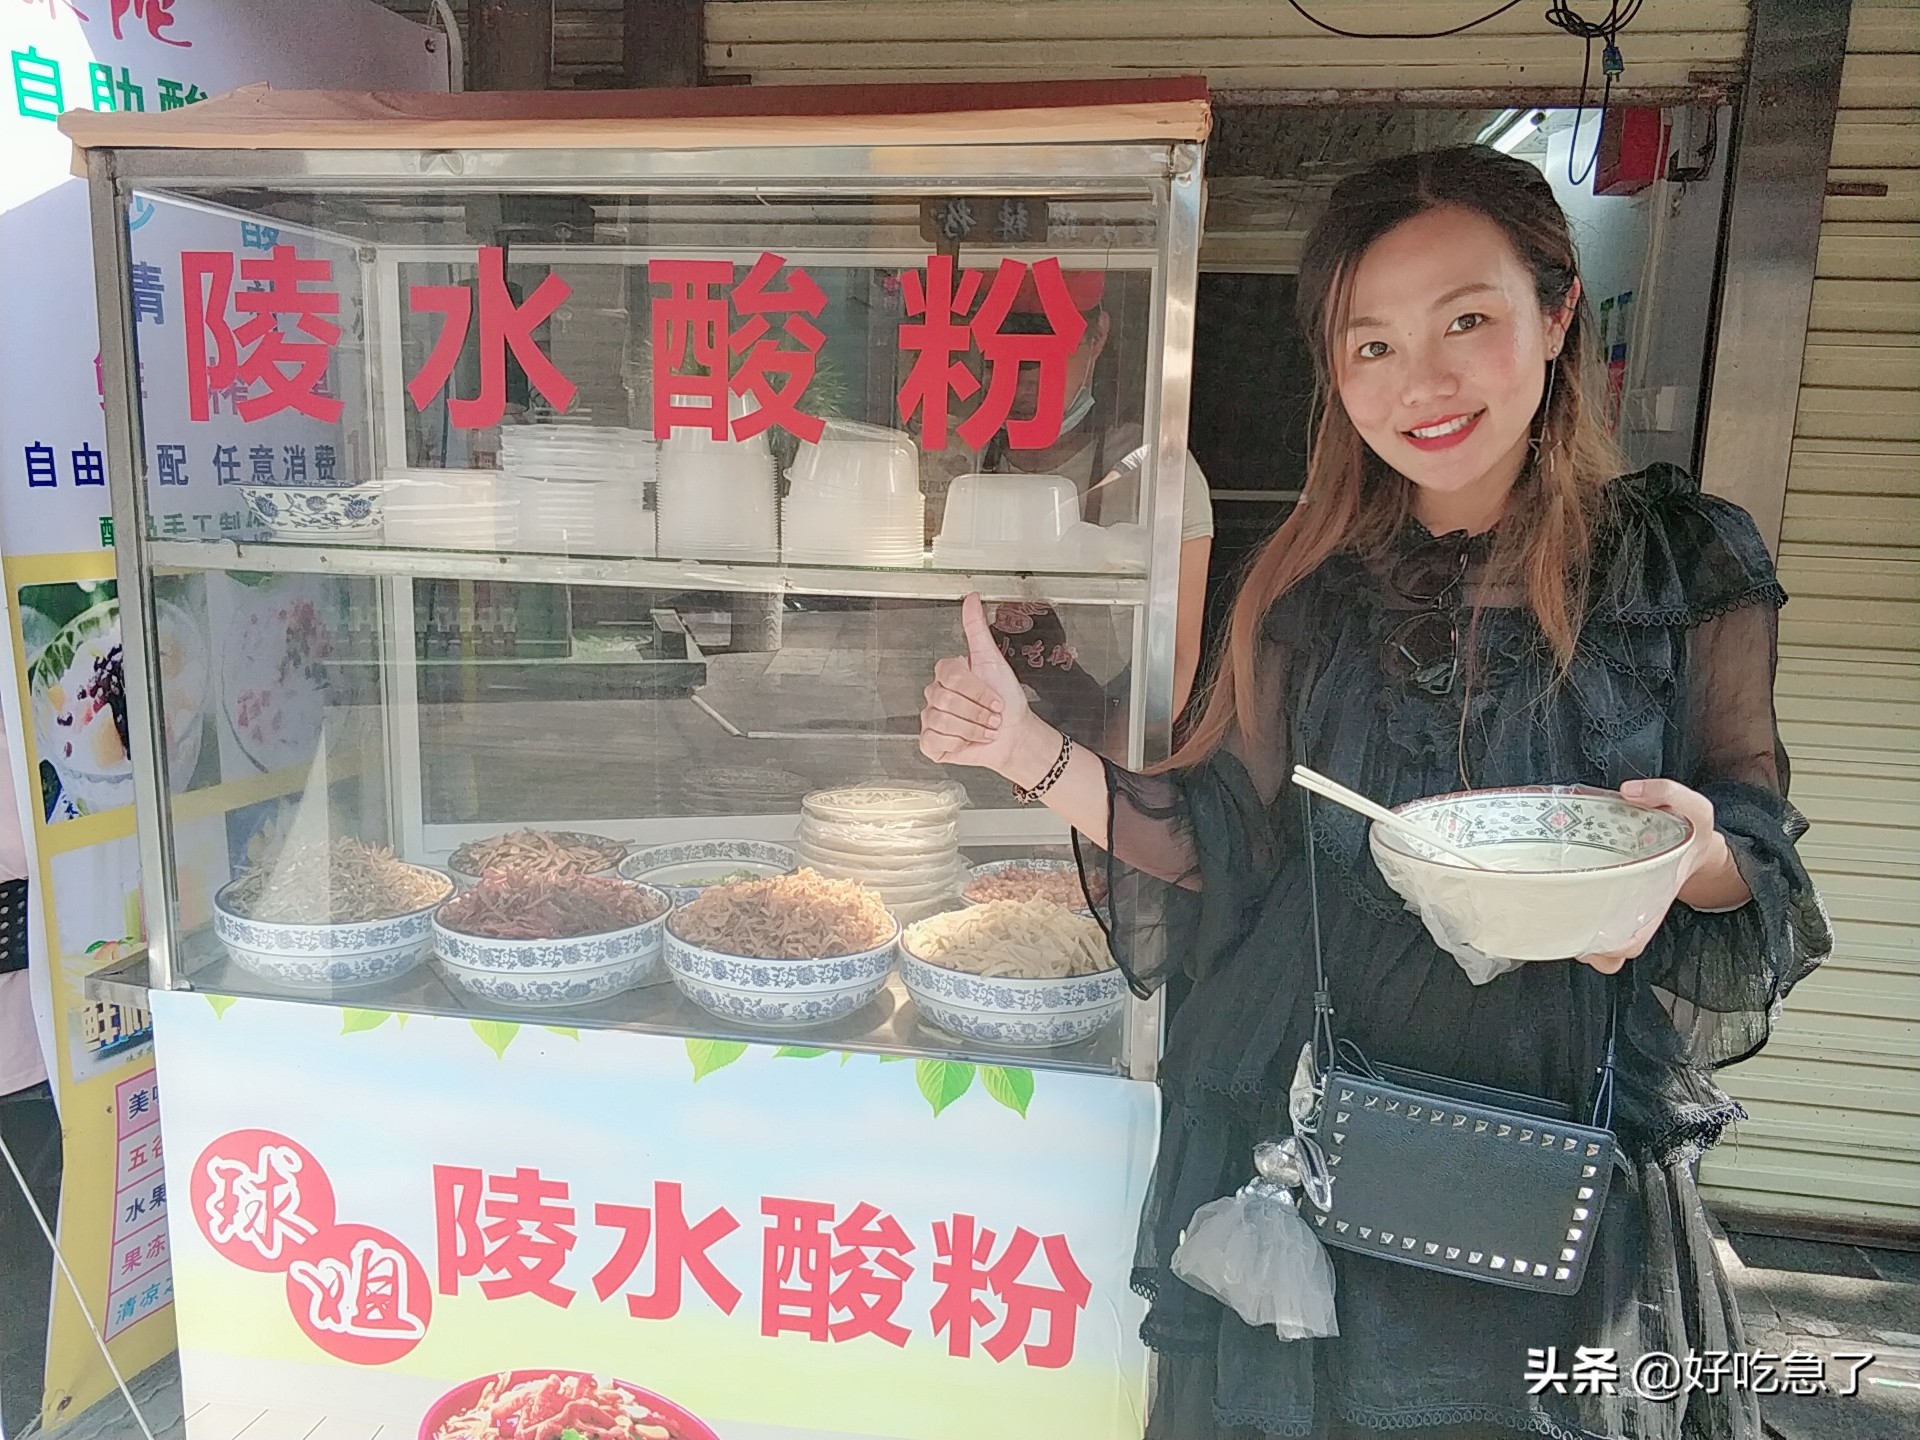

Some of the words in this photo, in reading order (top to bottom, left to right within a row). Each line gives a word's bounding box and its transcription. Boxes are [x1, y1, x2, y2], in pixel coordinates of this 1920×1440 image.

[180, 246, 1088, 453] 陵水酸粉
[24, 441, 189, 488] 自由配
[212, 443, 337, 487] 任意消费
[121, 1233, 166, 1276] 果冻
[432, 1164, 1093, 1369] 陵水酸粉
